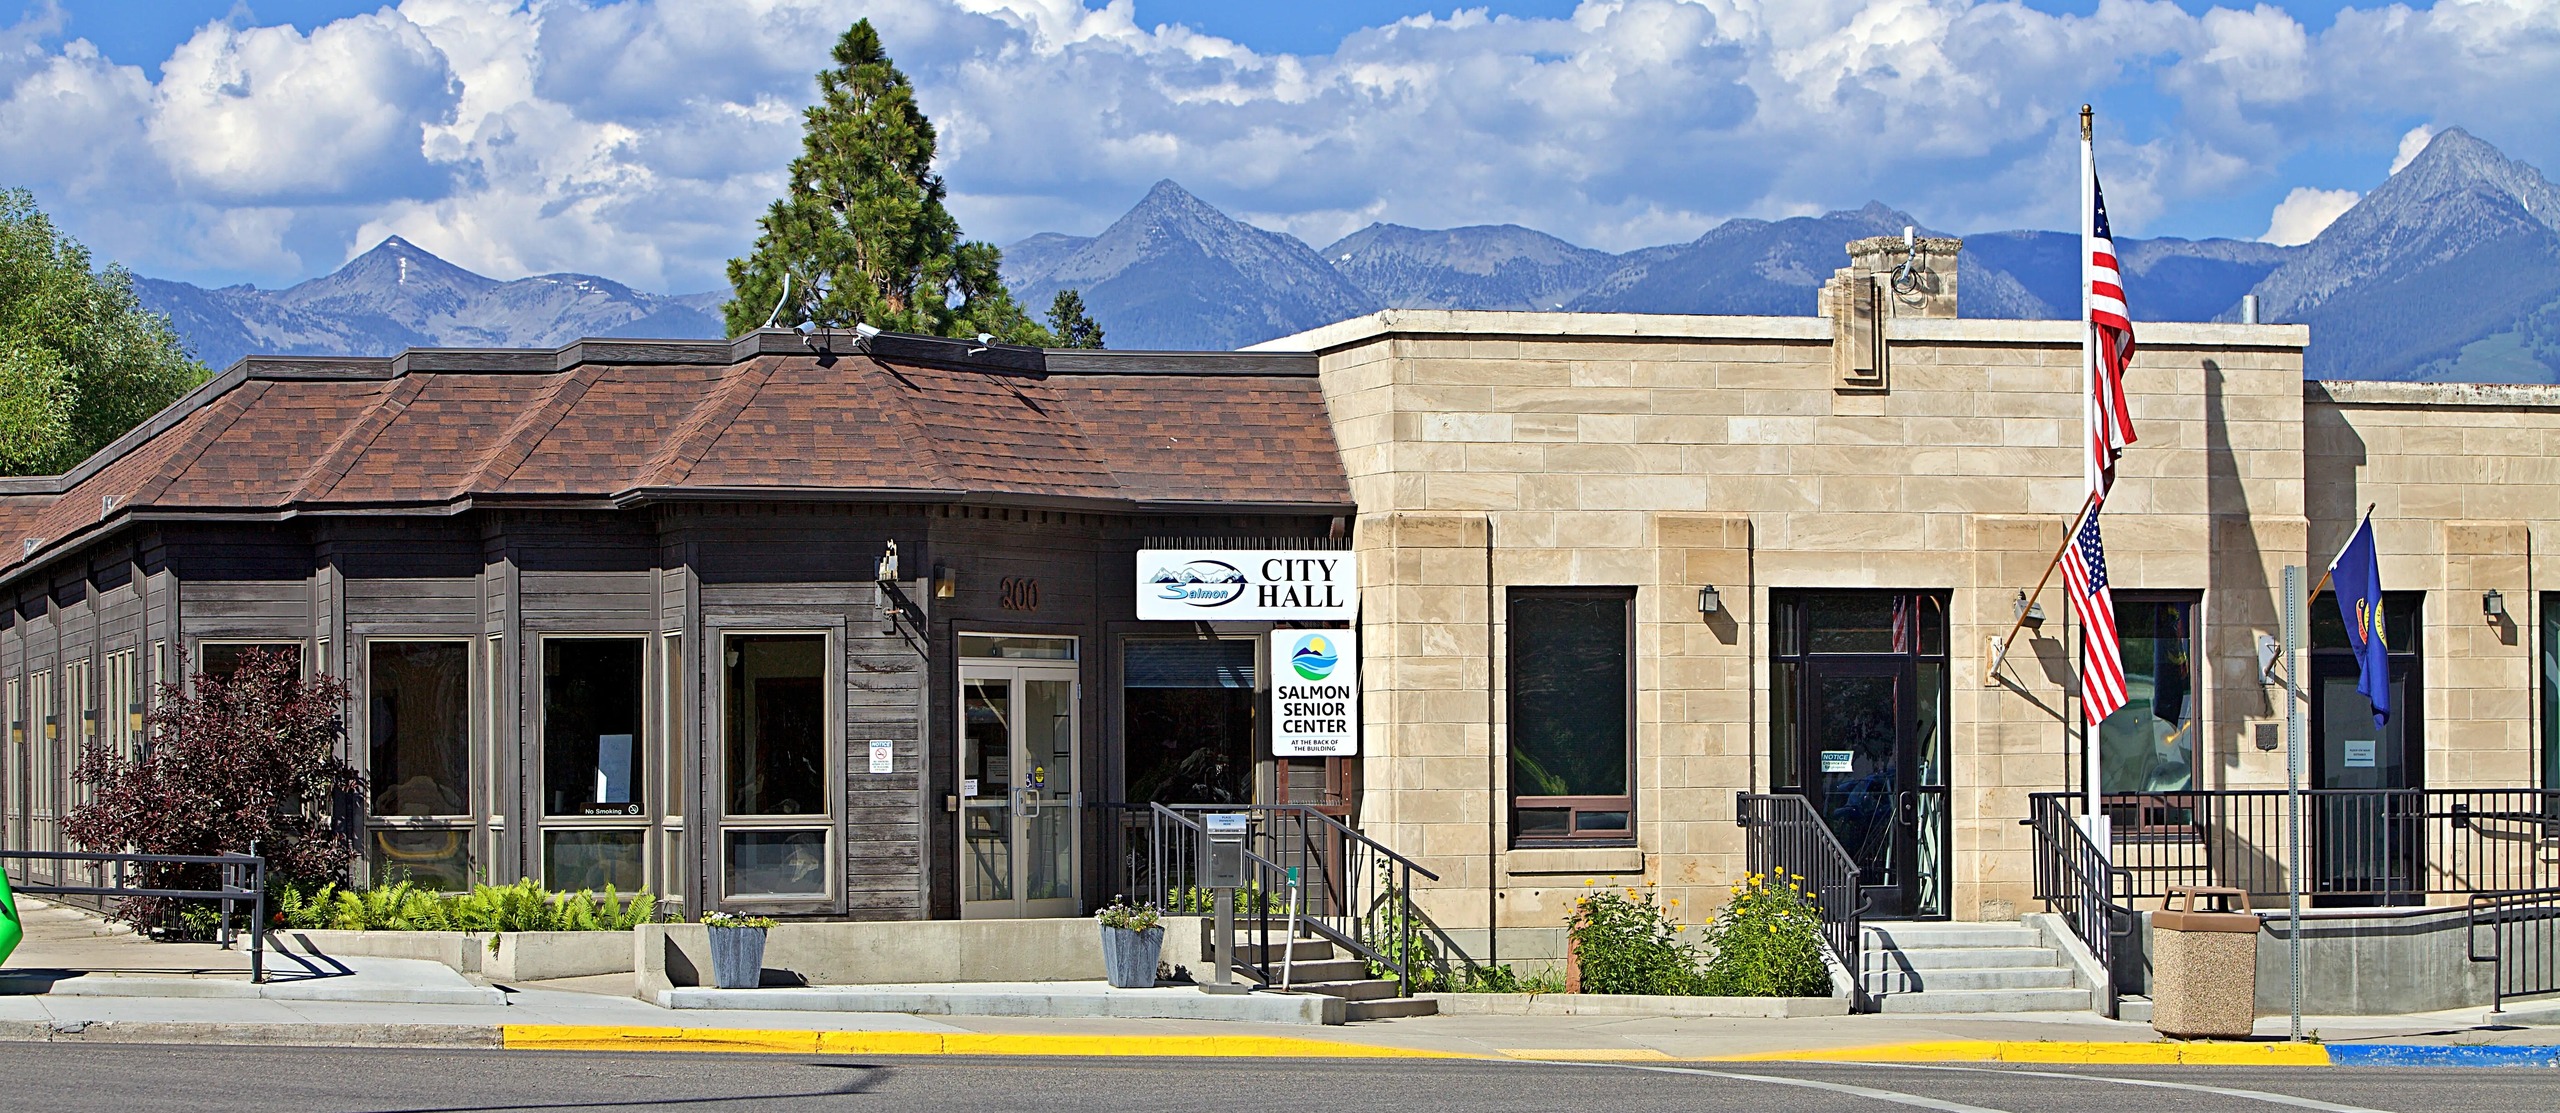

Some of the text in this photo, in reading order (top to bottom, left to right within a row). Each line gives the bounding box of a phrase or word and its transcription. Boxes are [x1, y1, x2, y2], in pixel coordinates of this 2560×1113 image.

[1261, 558, 1339, 582] CITY
[1002, 577, 1040, 612] 200
[1157, 582, 1229, 600] Salmon
[1257, 585, 1344, 608] HALL
[1278, 686, 1350, 699] SALMON
[1283, 702, 1346, 716] SENIOR
[1283, 719, 1347, 733] CENTER
